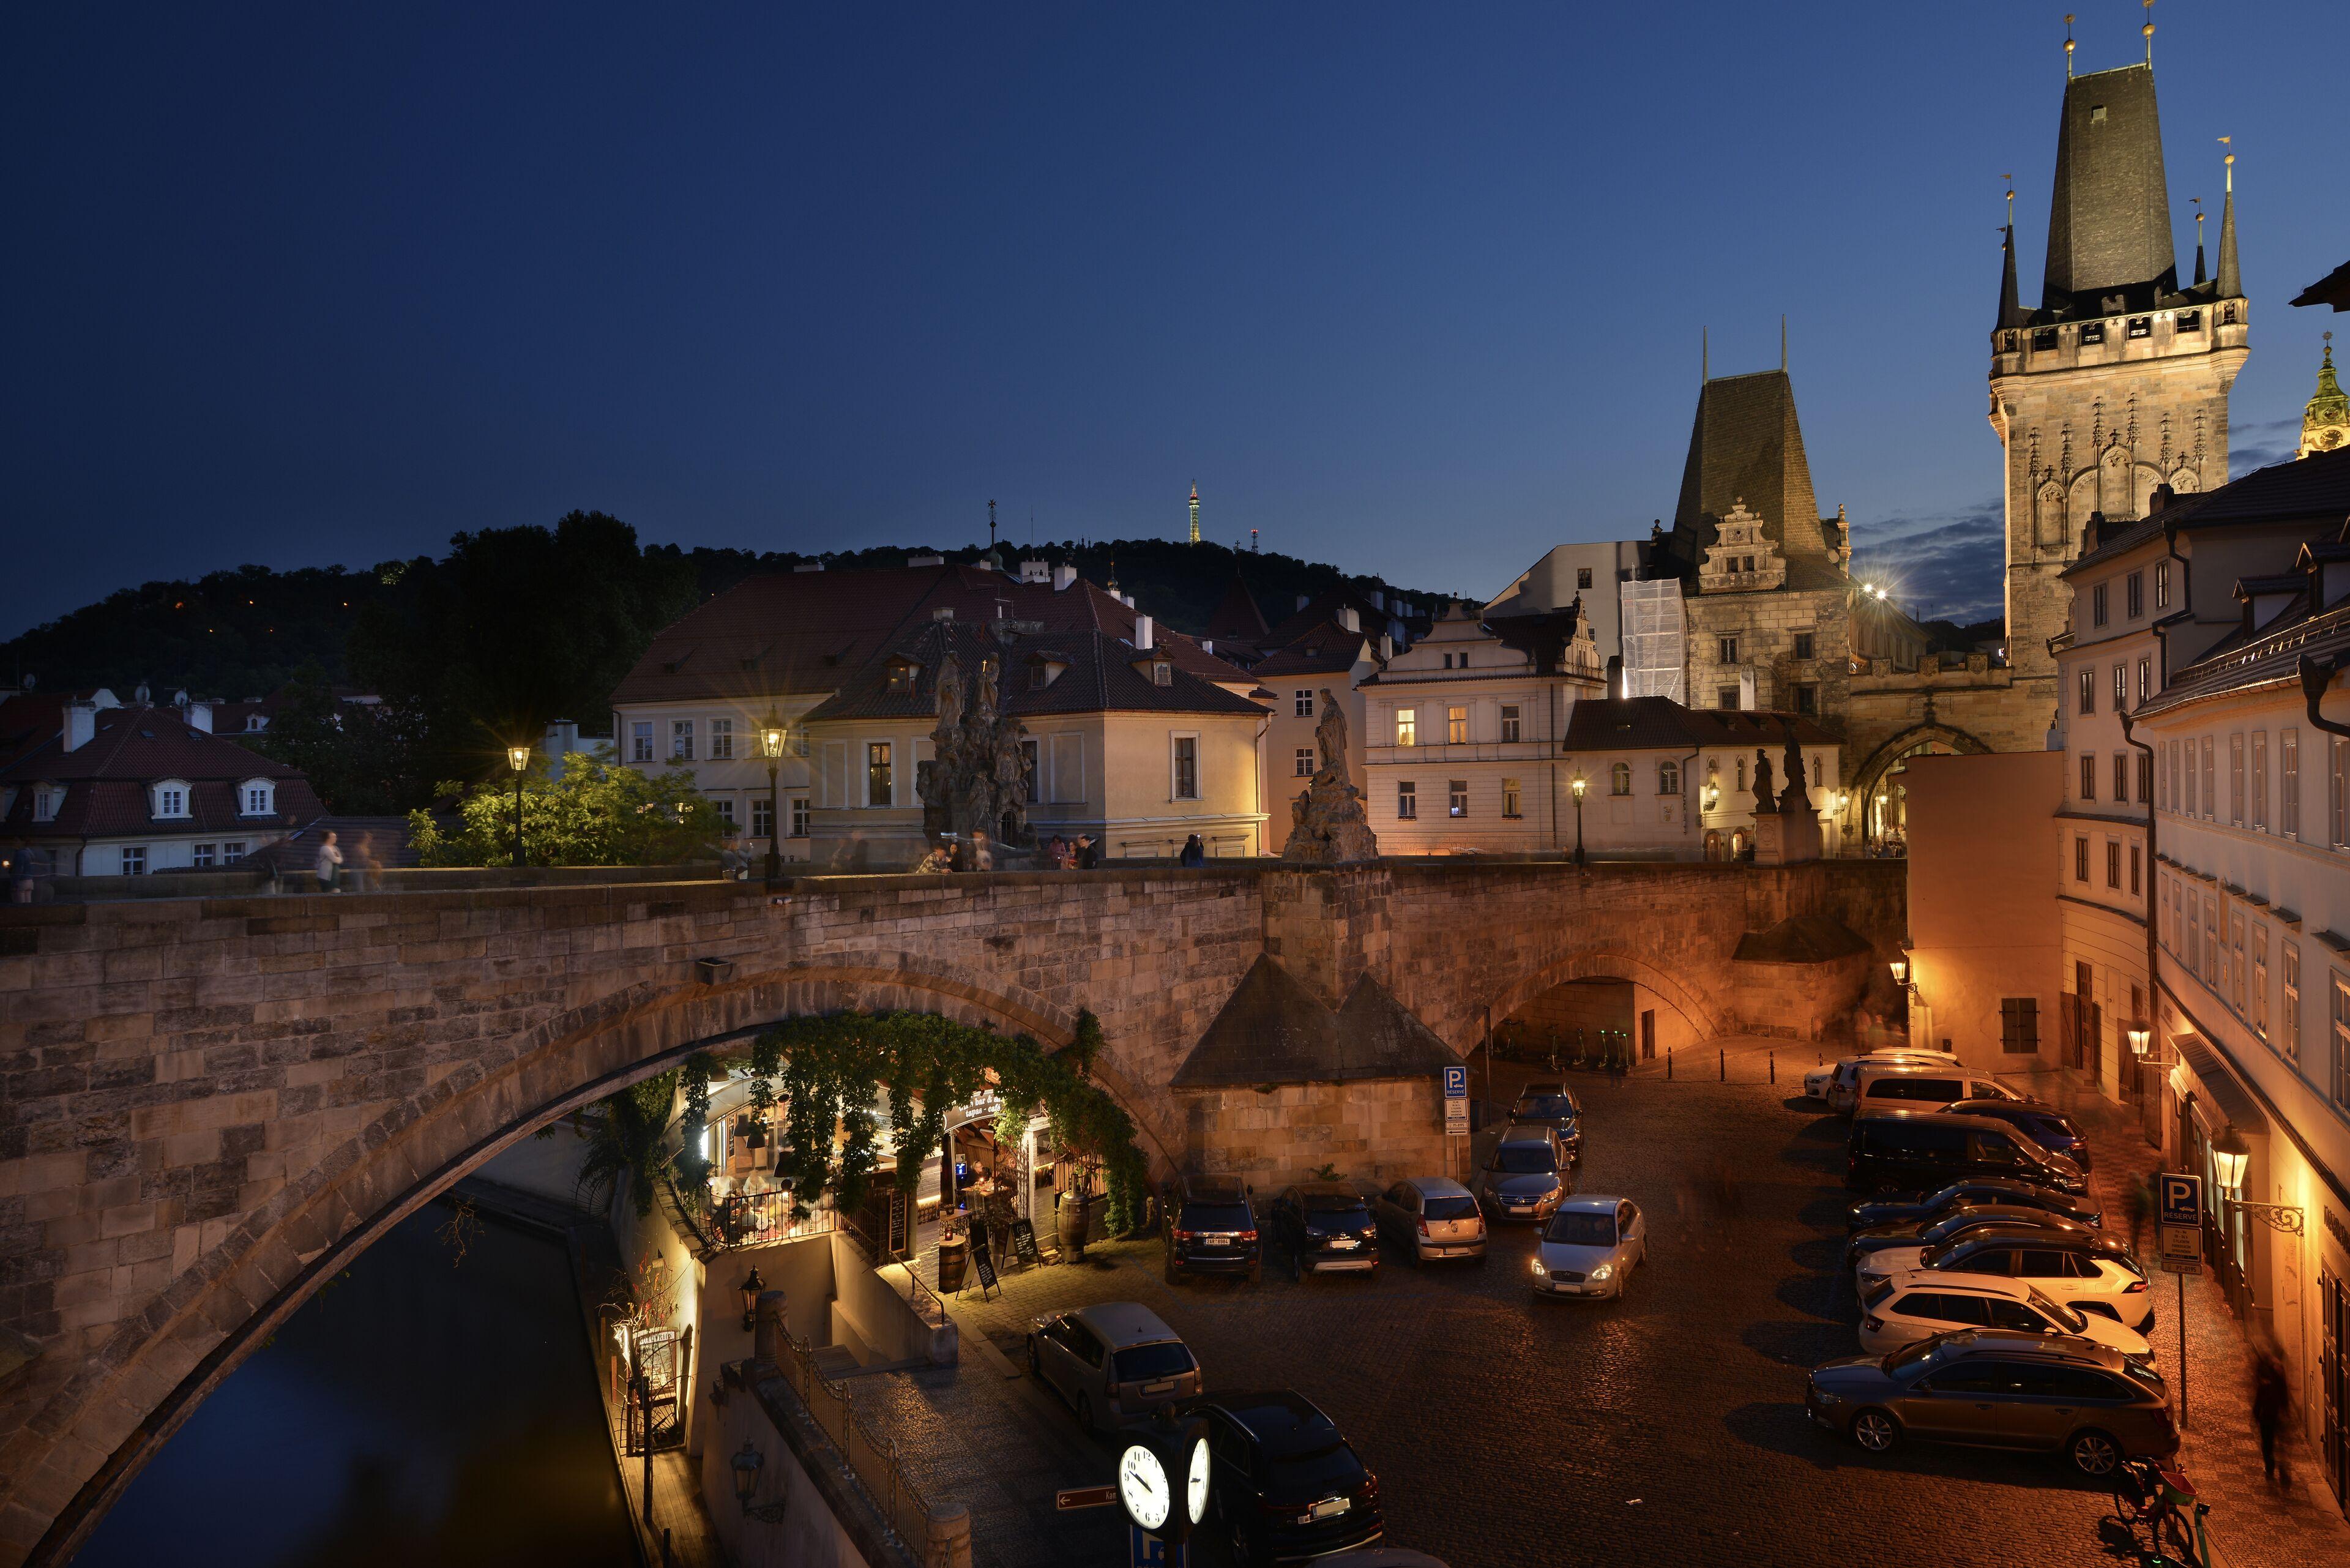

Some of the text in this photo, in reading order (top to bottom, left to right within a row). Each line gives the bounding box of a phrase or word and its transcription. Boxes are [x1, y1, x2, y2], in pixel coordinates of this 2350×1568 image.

[1449, 1071, 1461, 1088] P
[966, 1108, 982, 1118] tapas
[988, 1103, 1001, 1112] café
[2169, 1181, 2191, 1209] P
[2164, 1211, 2198, 1221] RÉSERVÉ
